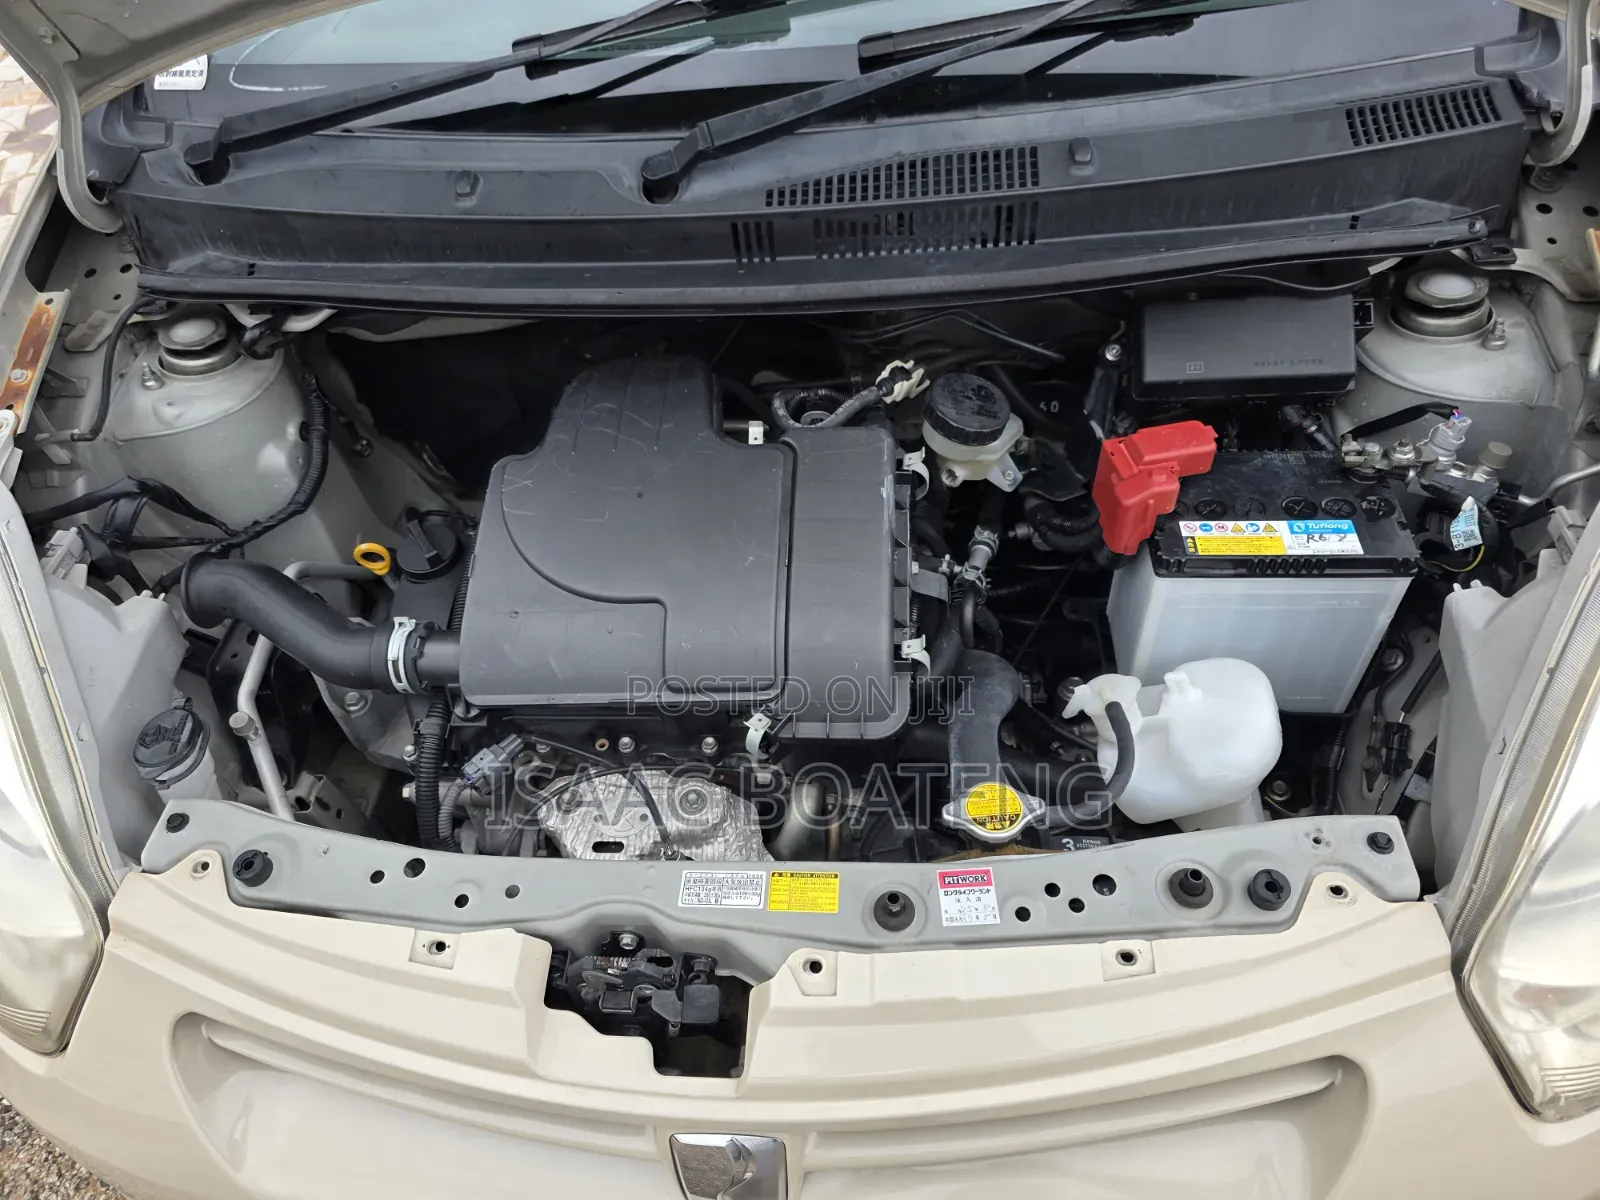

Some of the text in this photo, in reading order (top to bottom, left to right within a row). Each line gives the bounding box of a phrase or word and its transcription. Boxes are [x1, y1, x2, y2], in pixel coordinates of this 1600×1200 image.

[976, 814, 1017, 823] CAUTION
[1061, 837, 1075, 851] 3
[944, 874, 987, 885] PITWORK
